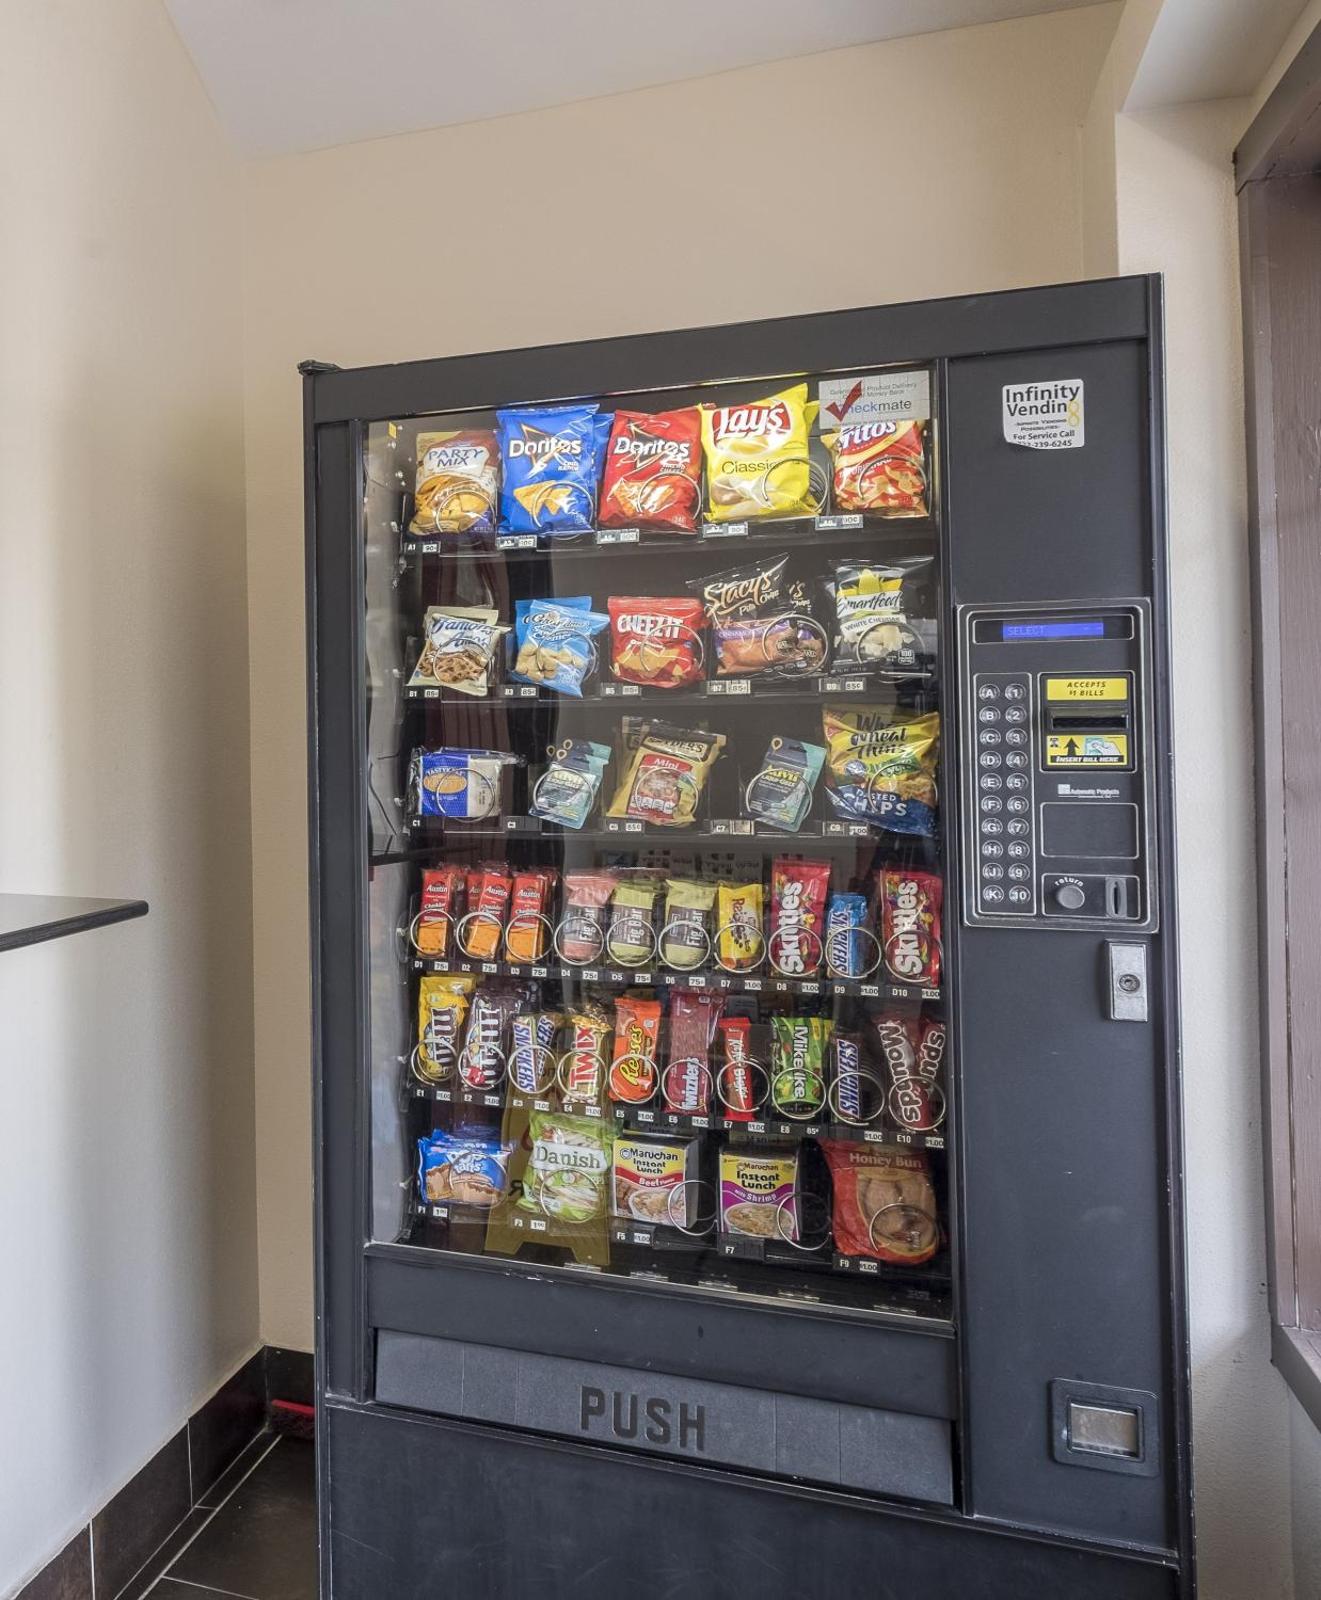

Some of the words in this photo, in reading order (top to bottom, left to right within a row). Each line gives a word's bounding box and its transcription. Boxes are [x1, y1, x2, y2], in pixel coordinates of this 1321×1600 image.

[1006, 385, 1080, 402] Infinity
[1028, 432, 1058, 440] Service
[1059, 430, 1075, 438] Call
[509, 438, 582, 457] Doritos
[614, 437, 690, 457] Doritos
[429, 449, 484, 460] PARTY
[437, 458, 468, 468] MIX
[722, 460, 780, 474] Classic
[704, 572, 772, 611] Stacy's
[1008, 626, 1045, 636] SELECT
[985, 689, 994, 698] A
[986, 711, 994, 720] B
[986, 734, 995, 742] C
[654, 758, 680, 770] Mini
[986, 756, 996, 764] D
[987, 779, 996, 787] E
[988, 801, 996, 809] F
[988, 823, 996, 832] G
[988, 846, 997, 854] H
[990, 868, 996, 876] J
[1054, 876, 1084, 887] return
[426, 884, 448, 894] Austin
[486, 887, 508, 897] Austin
[518, 890, 542, 898] Austin
[989, 890, 998, 899] K
[627, 928, 645, 945] Fig
[686, 930, 704, 946] Fig
[414, 960, 422, 968] D1
[720, 980, 730, 988] D7
[793, 1025, 810, 1069] Mike
[513, 1022, 536, 1092] SNICKERS
[569, 1027, 597, 1091] TWIX
[619, 1025, 643, 1086] Reese's
[878, 1023, 922, 1122] Mounds
[837, 1039, 859, 1118] SNICKERS
[794, 1072, 807, 1098] Ike
[780, 1126, 790, 1134] E8
[897, 1135, 912, 1143] E10
[536, 1146, 601, 1169] Danish
[630, 1148, 678, 1161] Maruchan
[633, 1158, 666, 1168] Instant
[849, 1153, 892, 1167] Honey
[896, 1156, 922, 1168] Bun
[636, 1166, 663, 1174] Lunch
[744, 1162, 778, 1171] Maruchan
[736, 1170, 780, 1181] Instant
[742, 1180, 776, 1190] Lunch
[747, 1193, 777, 1202] Shrimp
[726, 1246, 734, 1254] F7
[580, 1384, 706, 1451] PUSH
